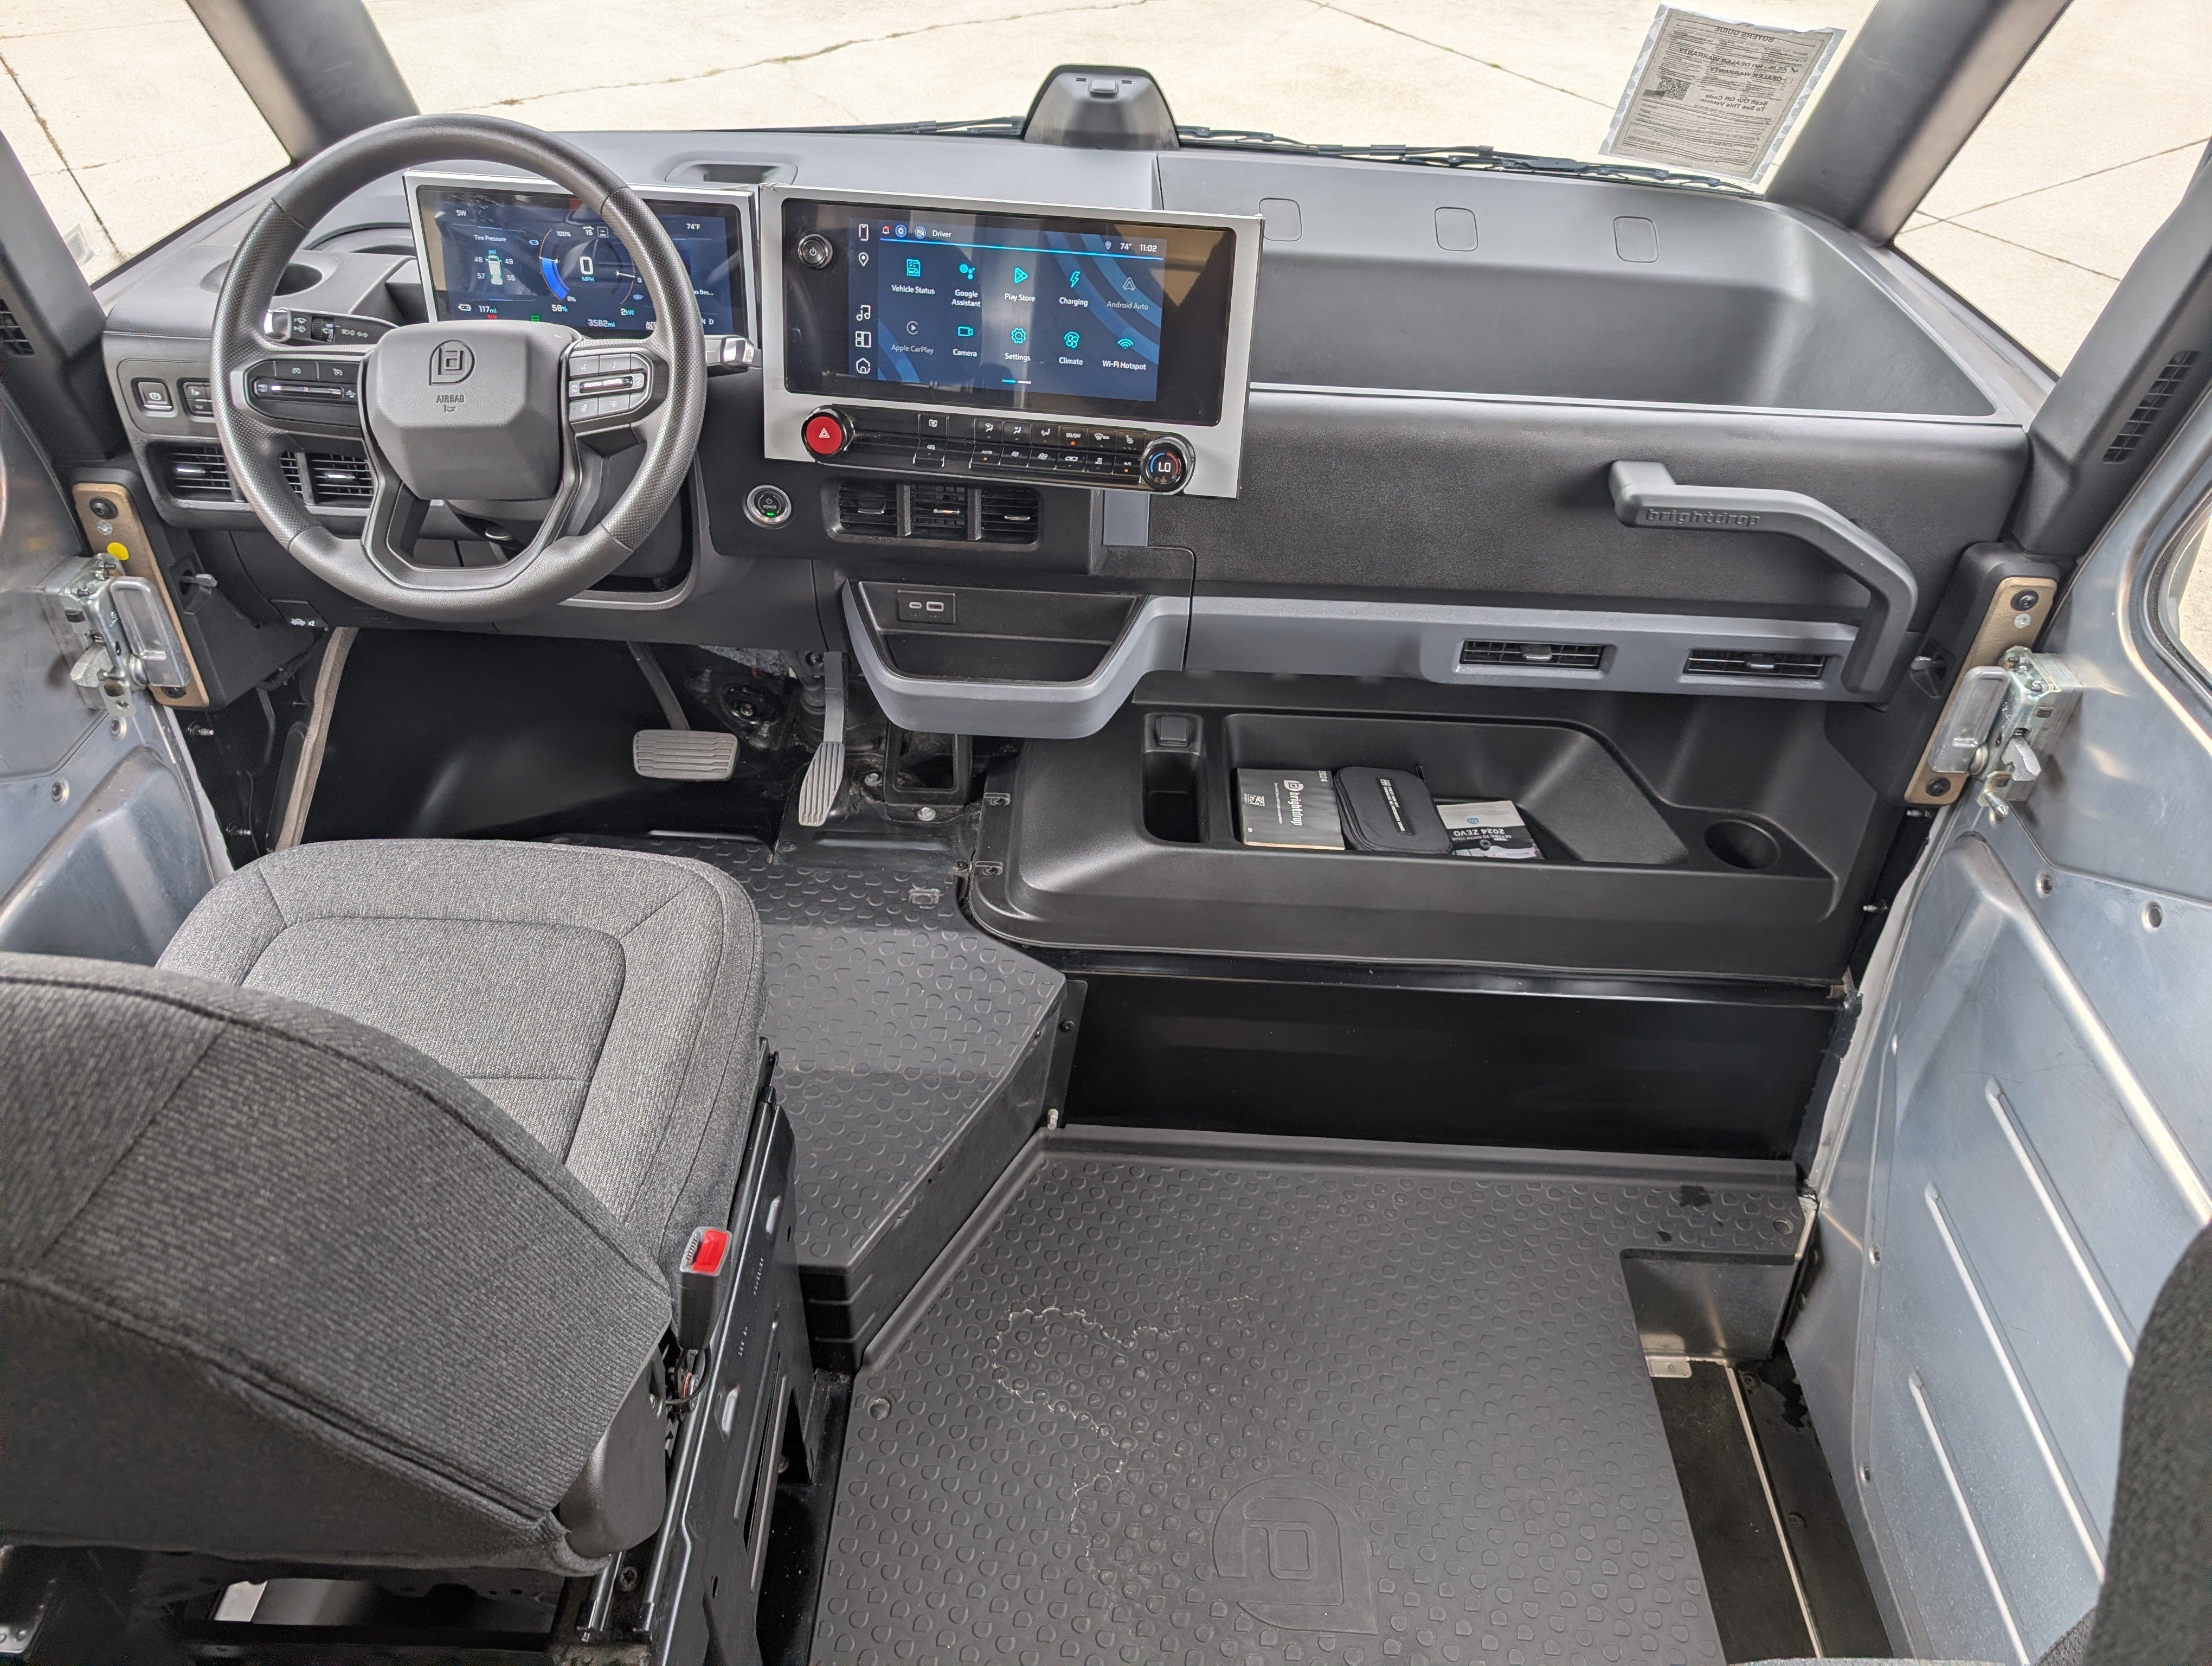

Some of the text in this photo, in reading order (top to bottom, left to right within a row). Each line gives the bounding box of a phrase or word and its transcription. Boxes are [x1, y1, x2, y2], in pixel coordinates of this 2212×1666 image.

[1140, 244, 1157, 253] 11:02
[580, 256, 594, 275] 0
[891, 284, 935, 295] Vehicle Status
[955, 290, 978, 299] Google
[1005, 293, 1036, 302] Play Store
[951, 298, 981, 307] Assistant
[1059, 297, 1089, 307] Charging
[1107, 300, 1133, 309] Android
[552, 304, 568, 312] 58%
[587, 319, 616, 328] 3582mi
[891, 344, 934, 355] Apple CarPlay
[953, 348, 978, 357] Camera
[1004, 353, 1031, 362] Settings
[1058, 356, 1084, 366] Climate
[1102, 360, 1147, 371] Wi-Fi Hotspot
[436, 394, 465, 403] AIRBAG
[1158, 462, 1171, 472] LO
[1646, 509, 1761, 527] brightdrop
[1318, 770, 1328, 782] 2024
[1287, 792, 1303, 826] brightdrop
